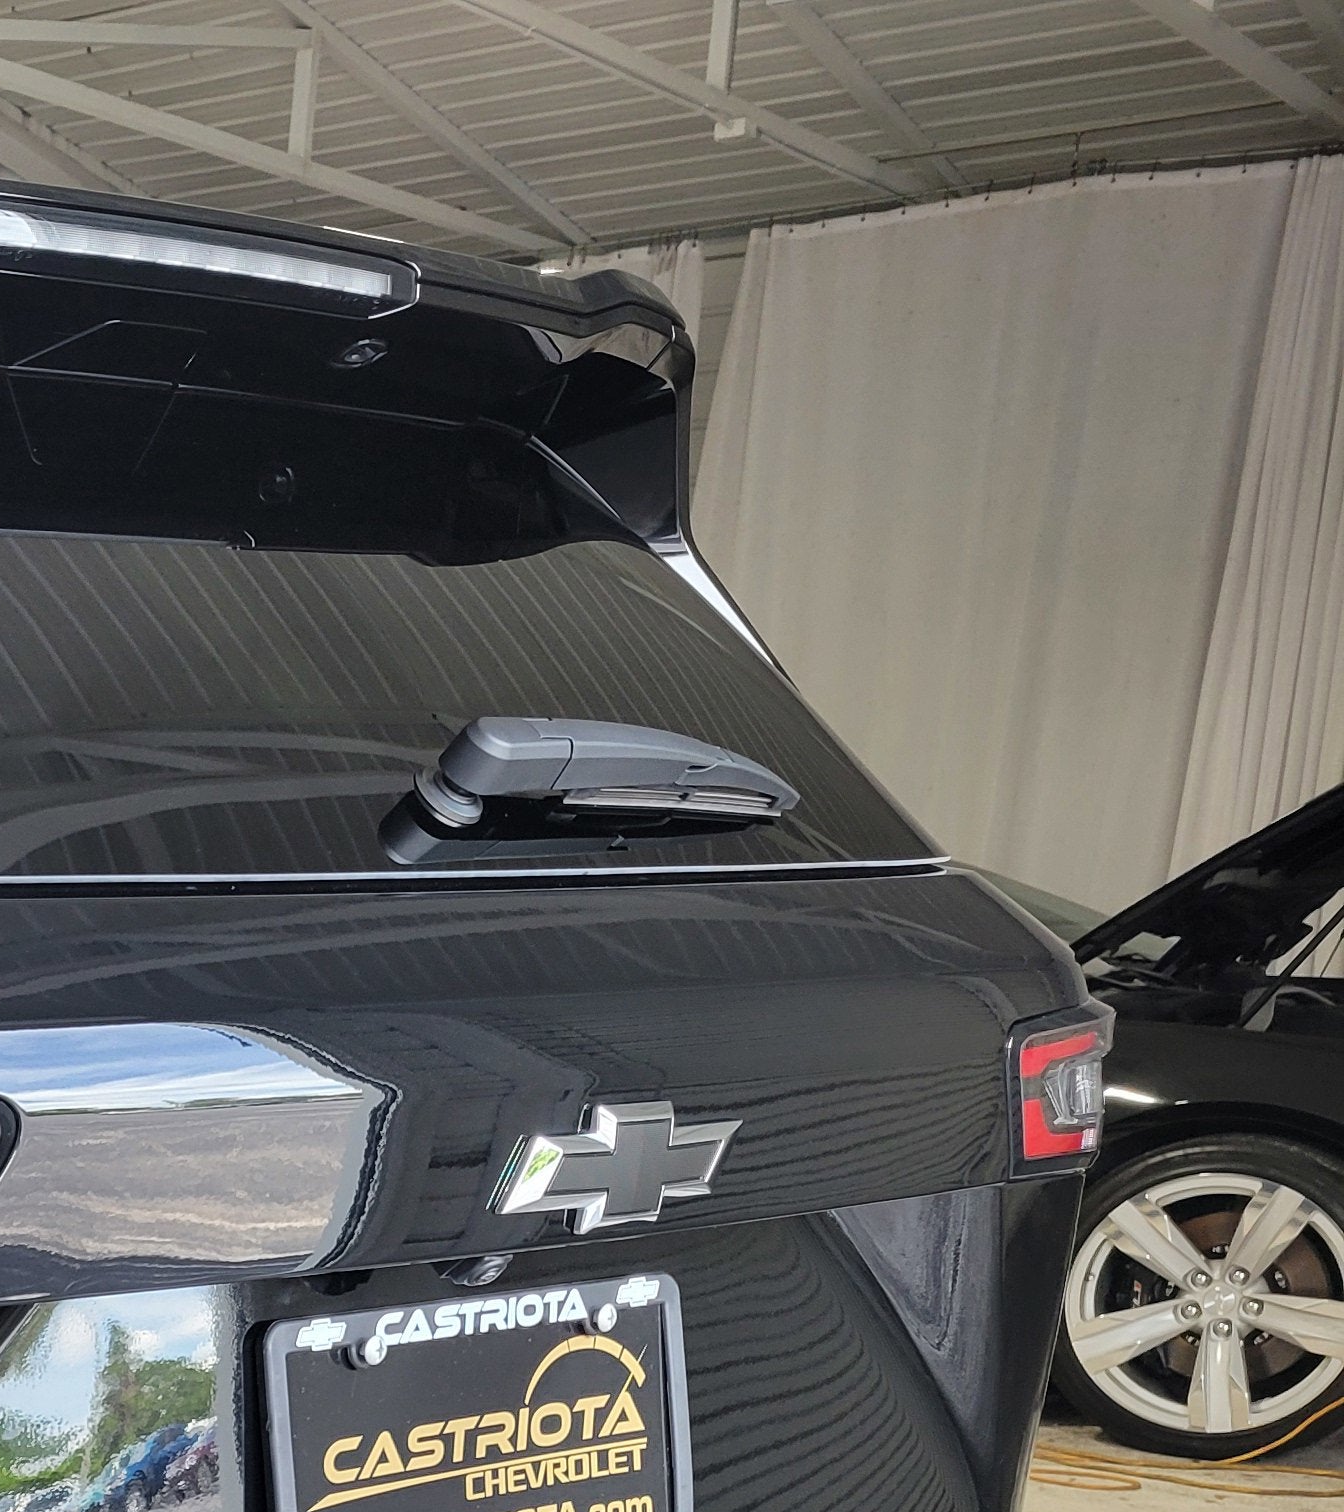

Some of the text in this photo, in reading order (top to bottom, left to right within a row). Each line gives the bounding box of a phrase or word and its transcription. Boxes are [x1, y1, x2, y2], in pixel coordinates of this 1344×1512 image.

[374, 1288, 588, 1346] CASTRIOTA
[322, 1391, 647, 1486] CASTRIOTA
[464, 1443, 648, 1501] CHEVROLET
